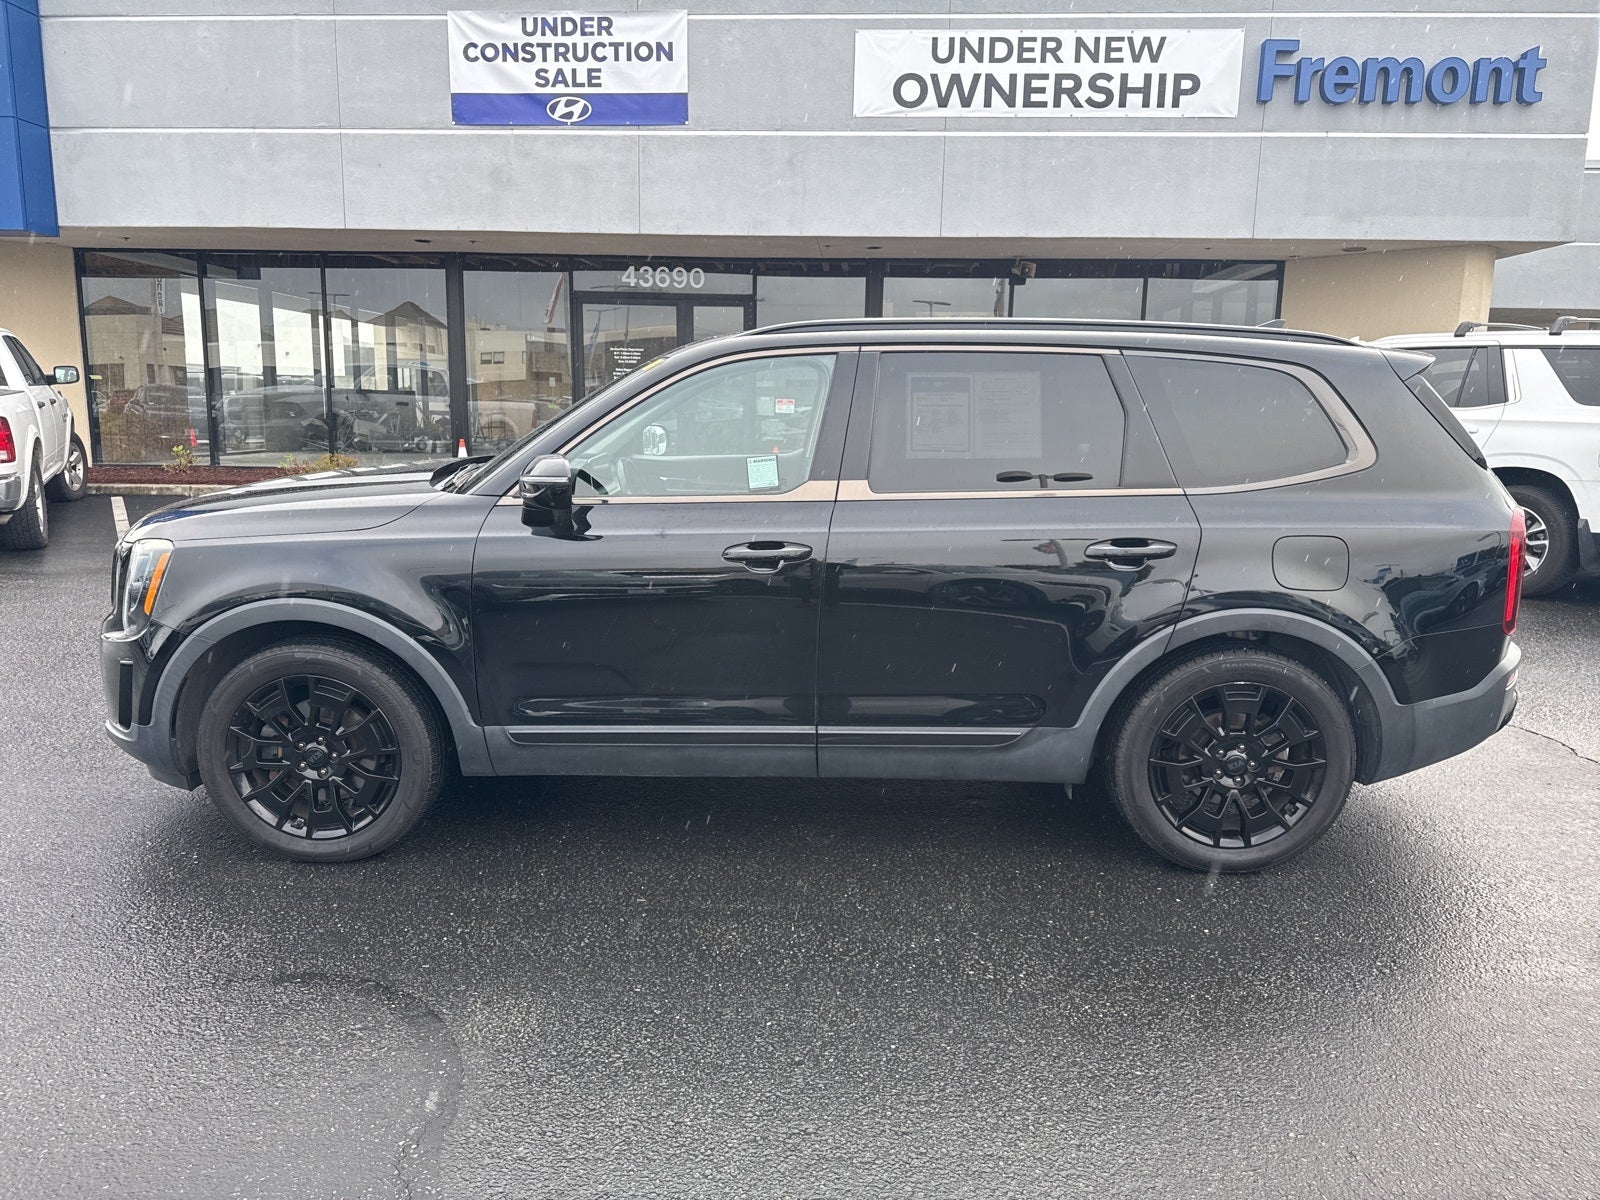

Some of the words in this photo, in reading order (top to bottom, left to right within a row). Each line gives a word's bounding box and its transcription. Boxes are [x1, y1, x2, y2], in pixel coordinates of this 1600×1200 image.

[521, 16, 613, 37] UNDER
[462, 41, 674, 63] CONSTRUCTION
[931, 36, 1064, 64] UNDER
[1074, 36, 1167, 64] NEW
[534, 67, 602, 88] SALE
[1256, 38, 1548, 106] Fremont
[892, 72, 1201, 109] OWNERSHIP
[621, 265, 705, 289] 43690
